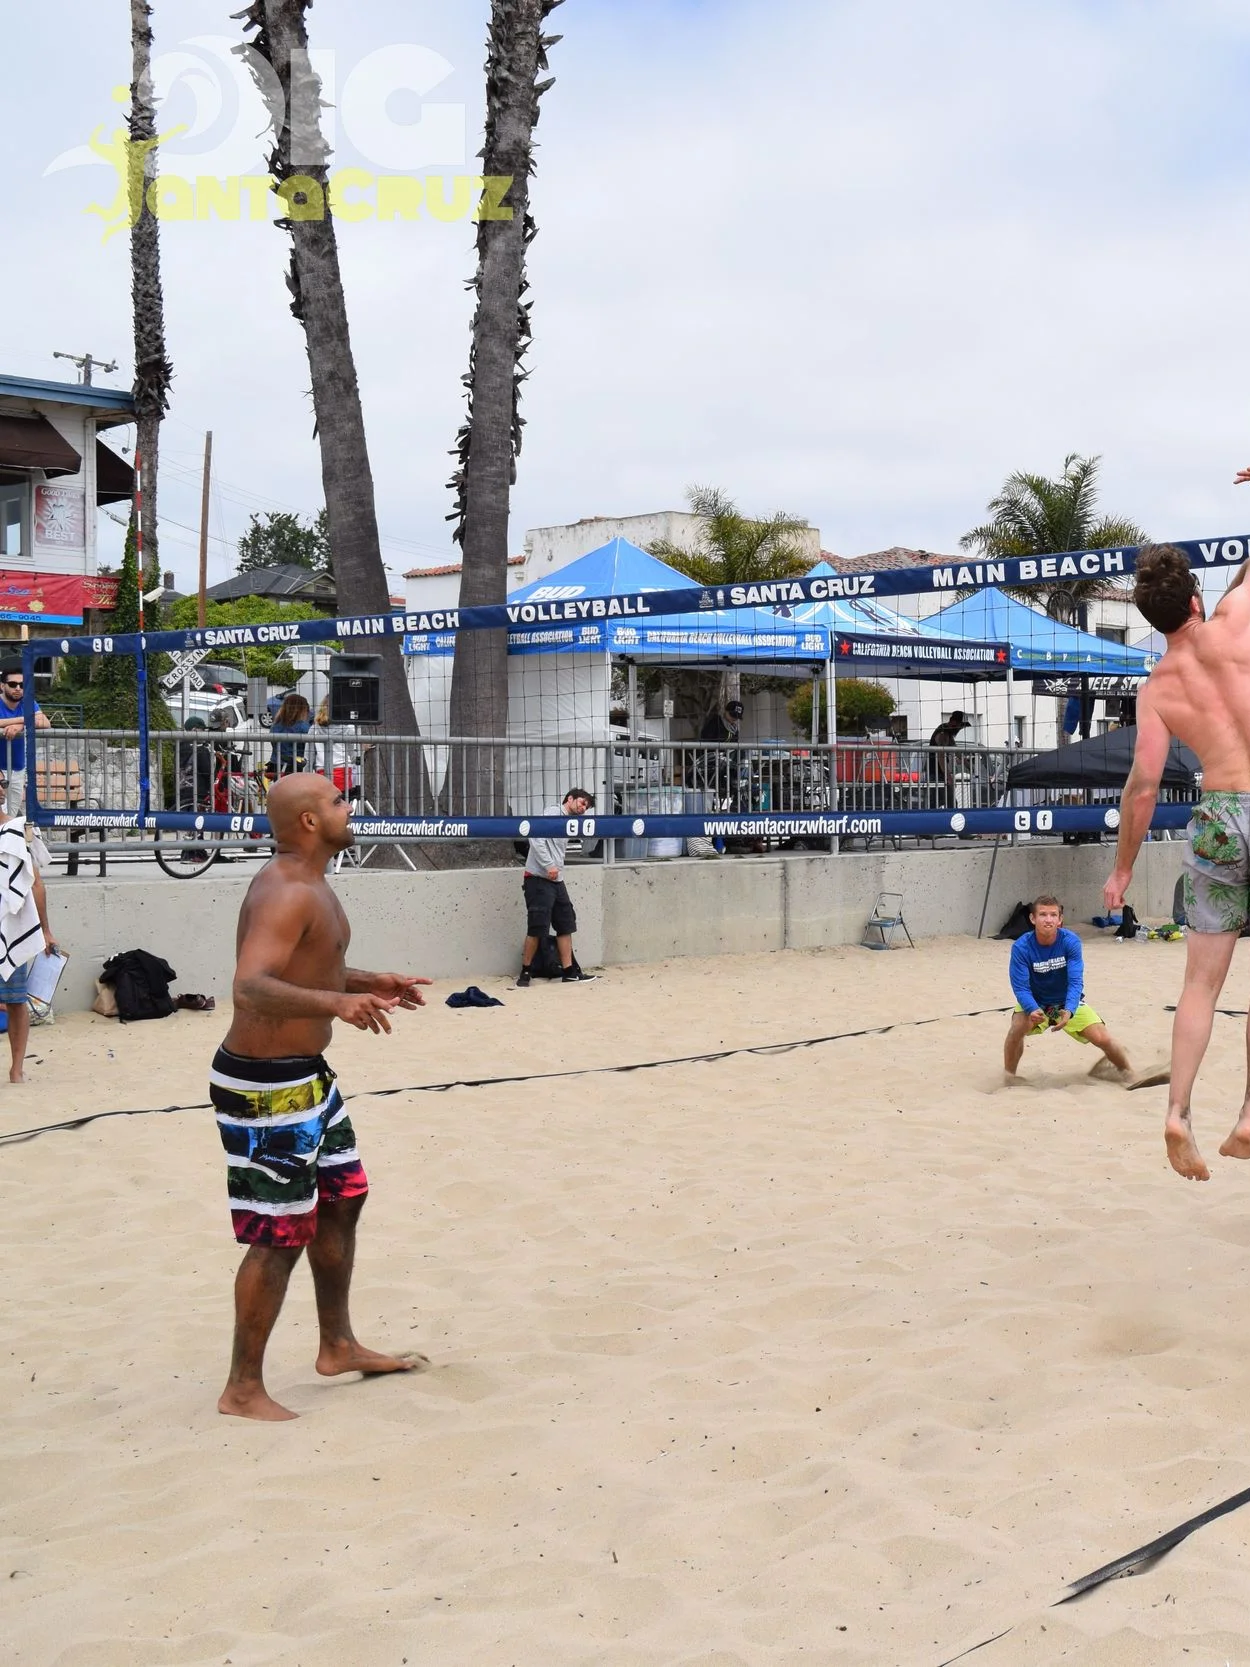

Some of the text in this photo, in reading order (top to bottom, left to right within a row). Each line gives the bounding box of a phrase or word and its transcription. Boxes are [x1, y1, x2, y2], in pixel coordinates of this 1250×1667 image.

[932, 551, 1124, 588] MAIN BEACH
[527, 585, 587, 600] BUD
[730, 585, 805, 606] SANTA
[810, 575, 875, 600] CRUZ
[506, 596, 651, 623] VOLLEYBALL
[336, 611, 460, 636] MAIN BEACH
[205, 624, 301, 646] SANTA CRUZ
[507, 632, 531, 645] LEYBALL
[852, 642, 995, 662] CALIFORNIA BEACH VOLLEYBALL ASSOCIATION
[54, 812, 156, 829] www.santacruzwharf.m
[346, 819, 468, 837] w.santacruzwharf.com
[704, 815, 882, 836] www.santacruzwharf.com
